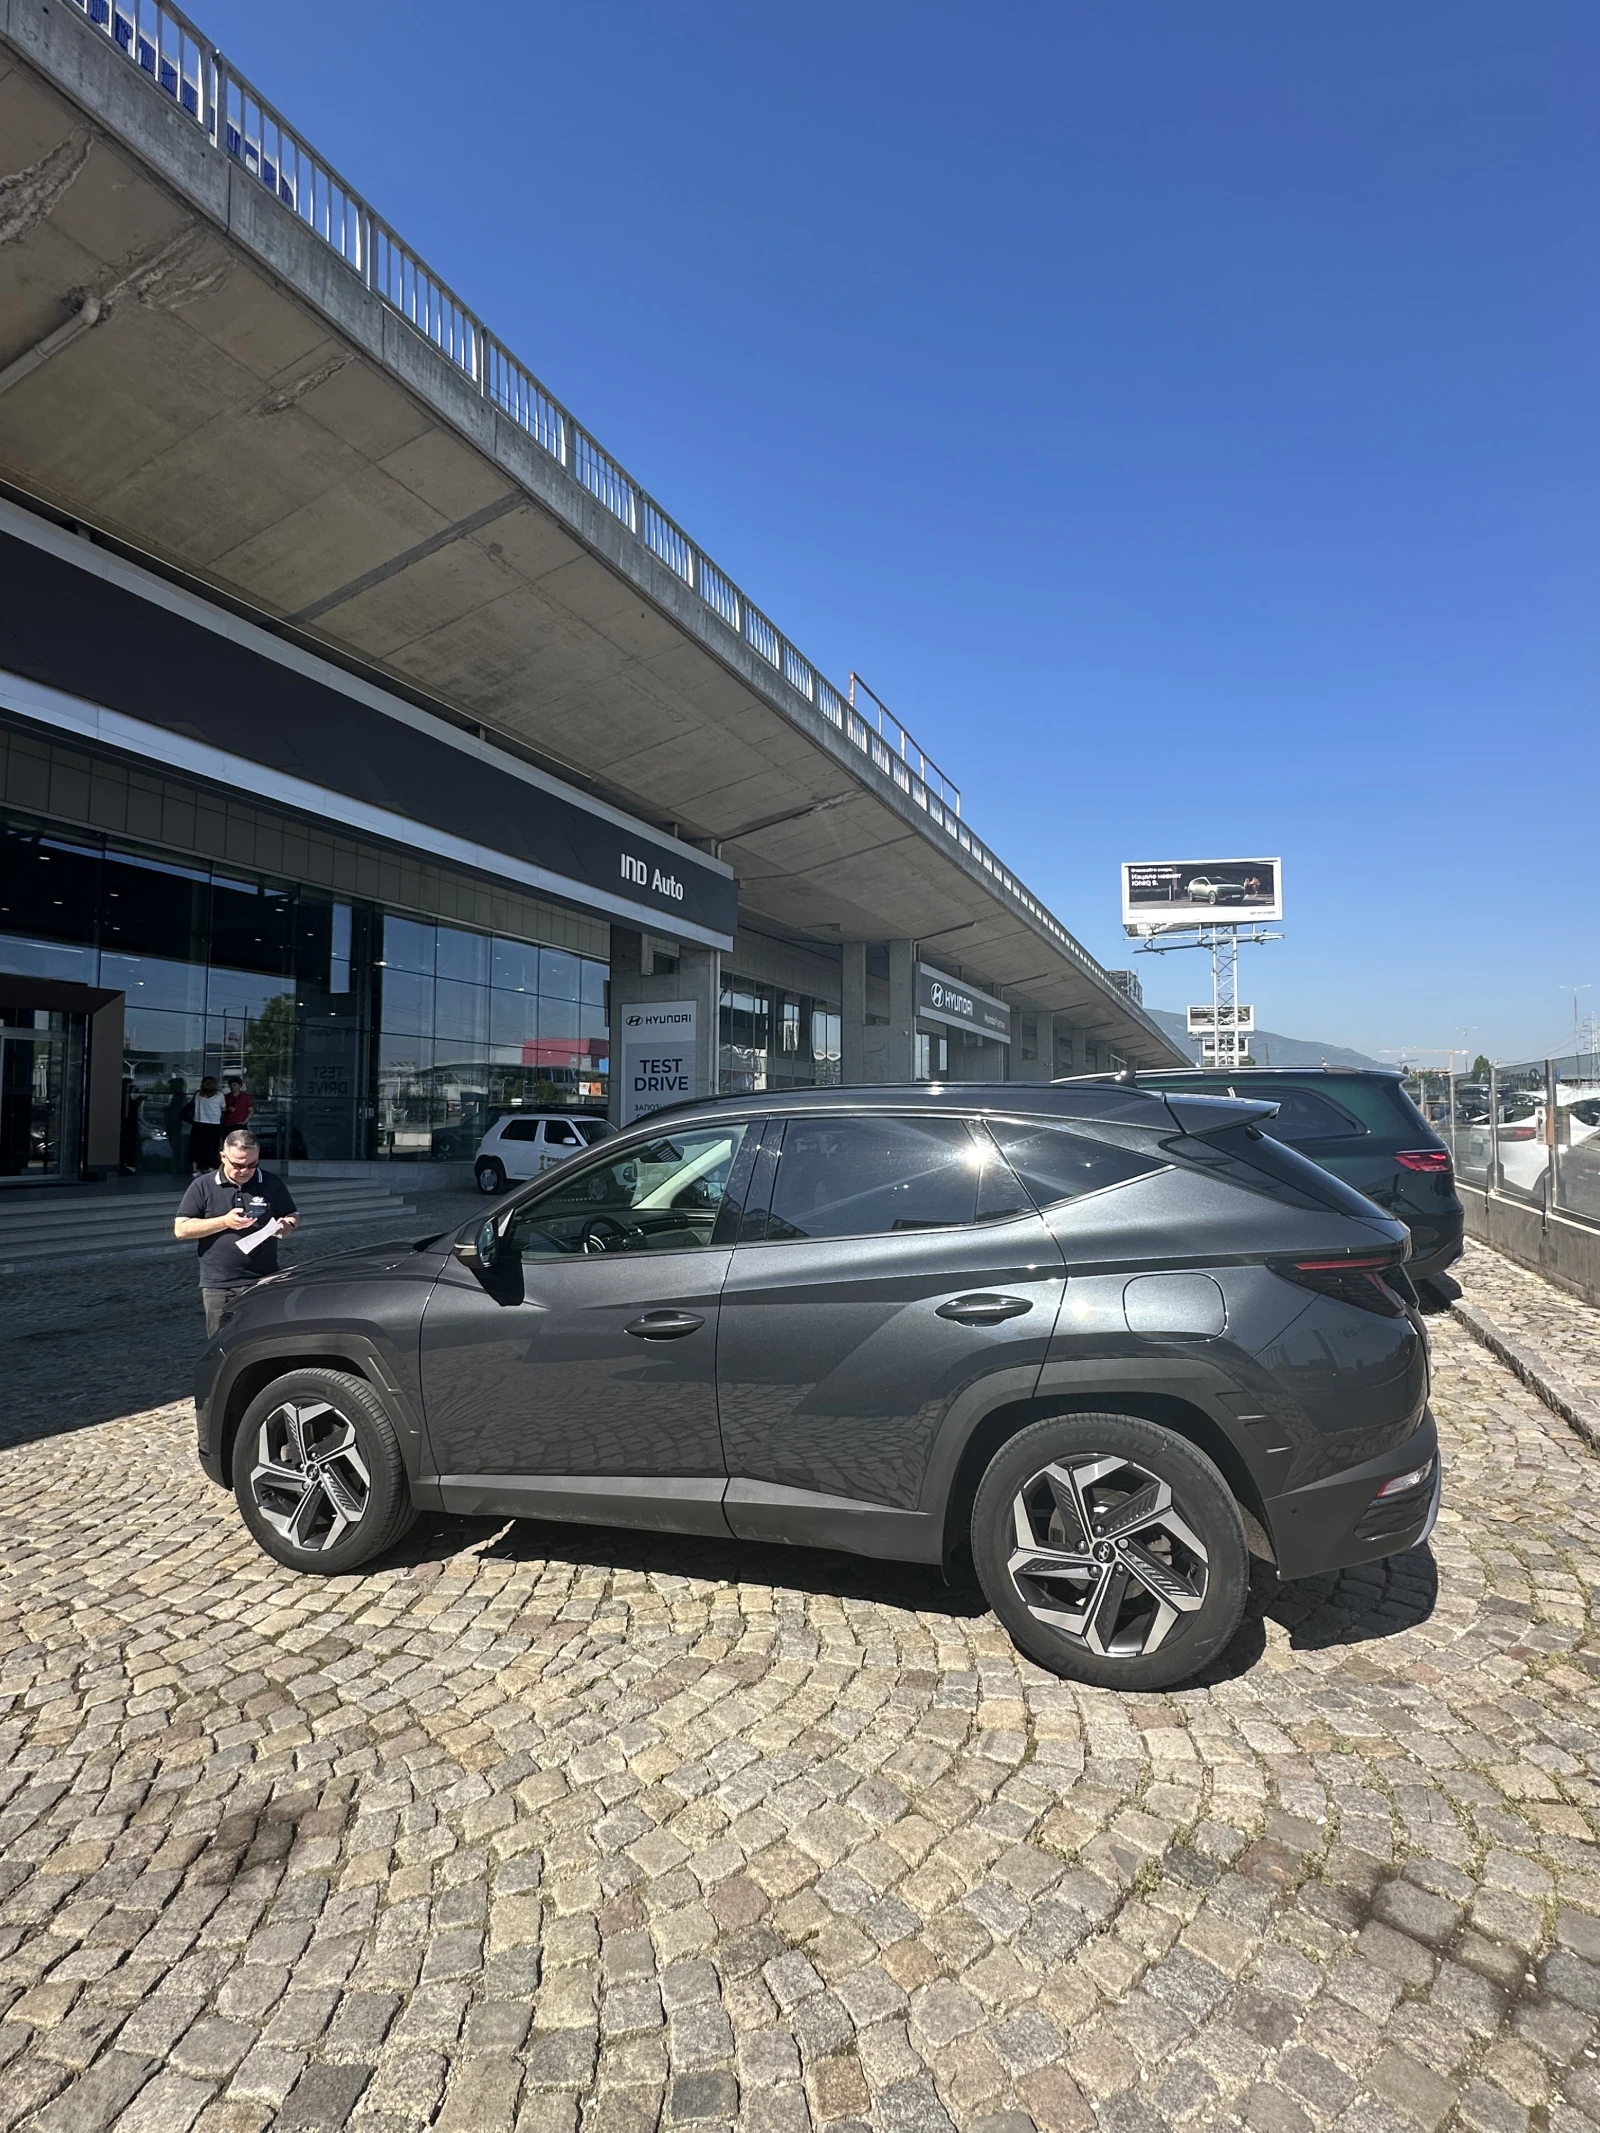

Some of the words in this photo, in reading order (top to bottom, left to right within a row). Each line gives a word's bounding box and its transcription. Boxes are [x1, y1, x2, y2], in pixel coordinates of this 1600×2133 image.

[620, 853, 648, 886] IND
[651, 868, 684, 901] Auto
[945, 990, 974, 1017] HYUNDAI
[645, 1014, 692, 1025] HYUNDAI
[640, 1058, 683, 1074] TEST
[634, 1076, 689, 1092] DRIVE
